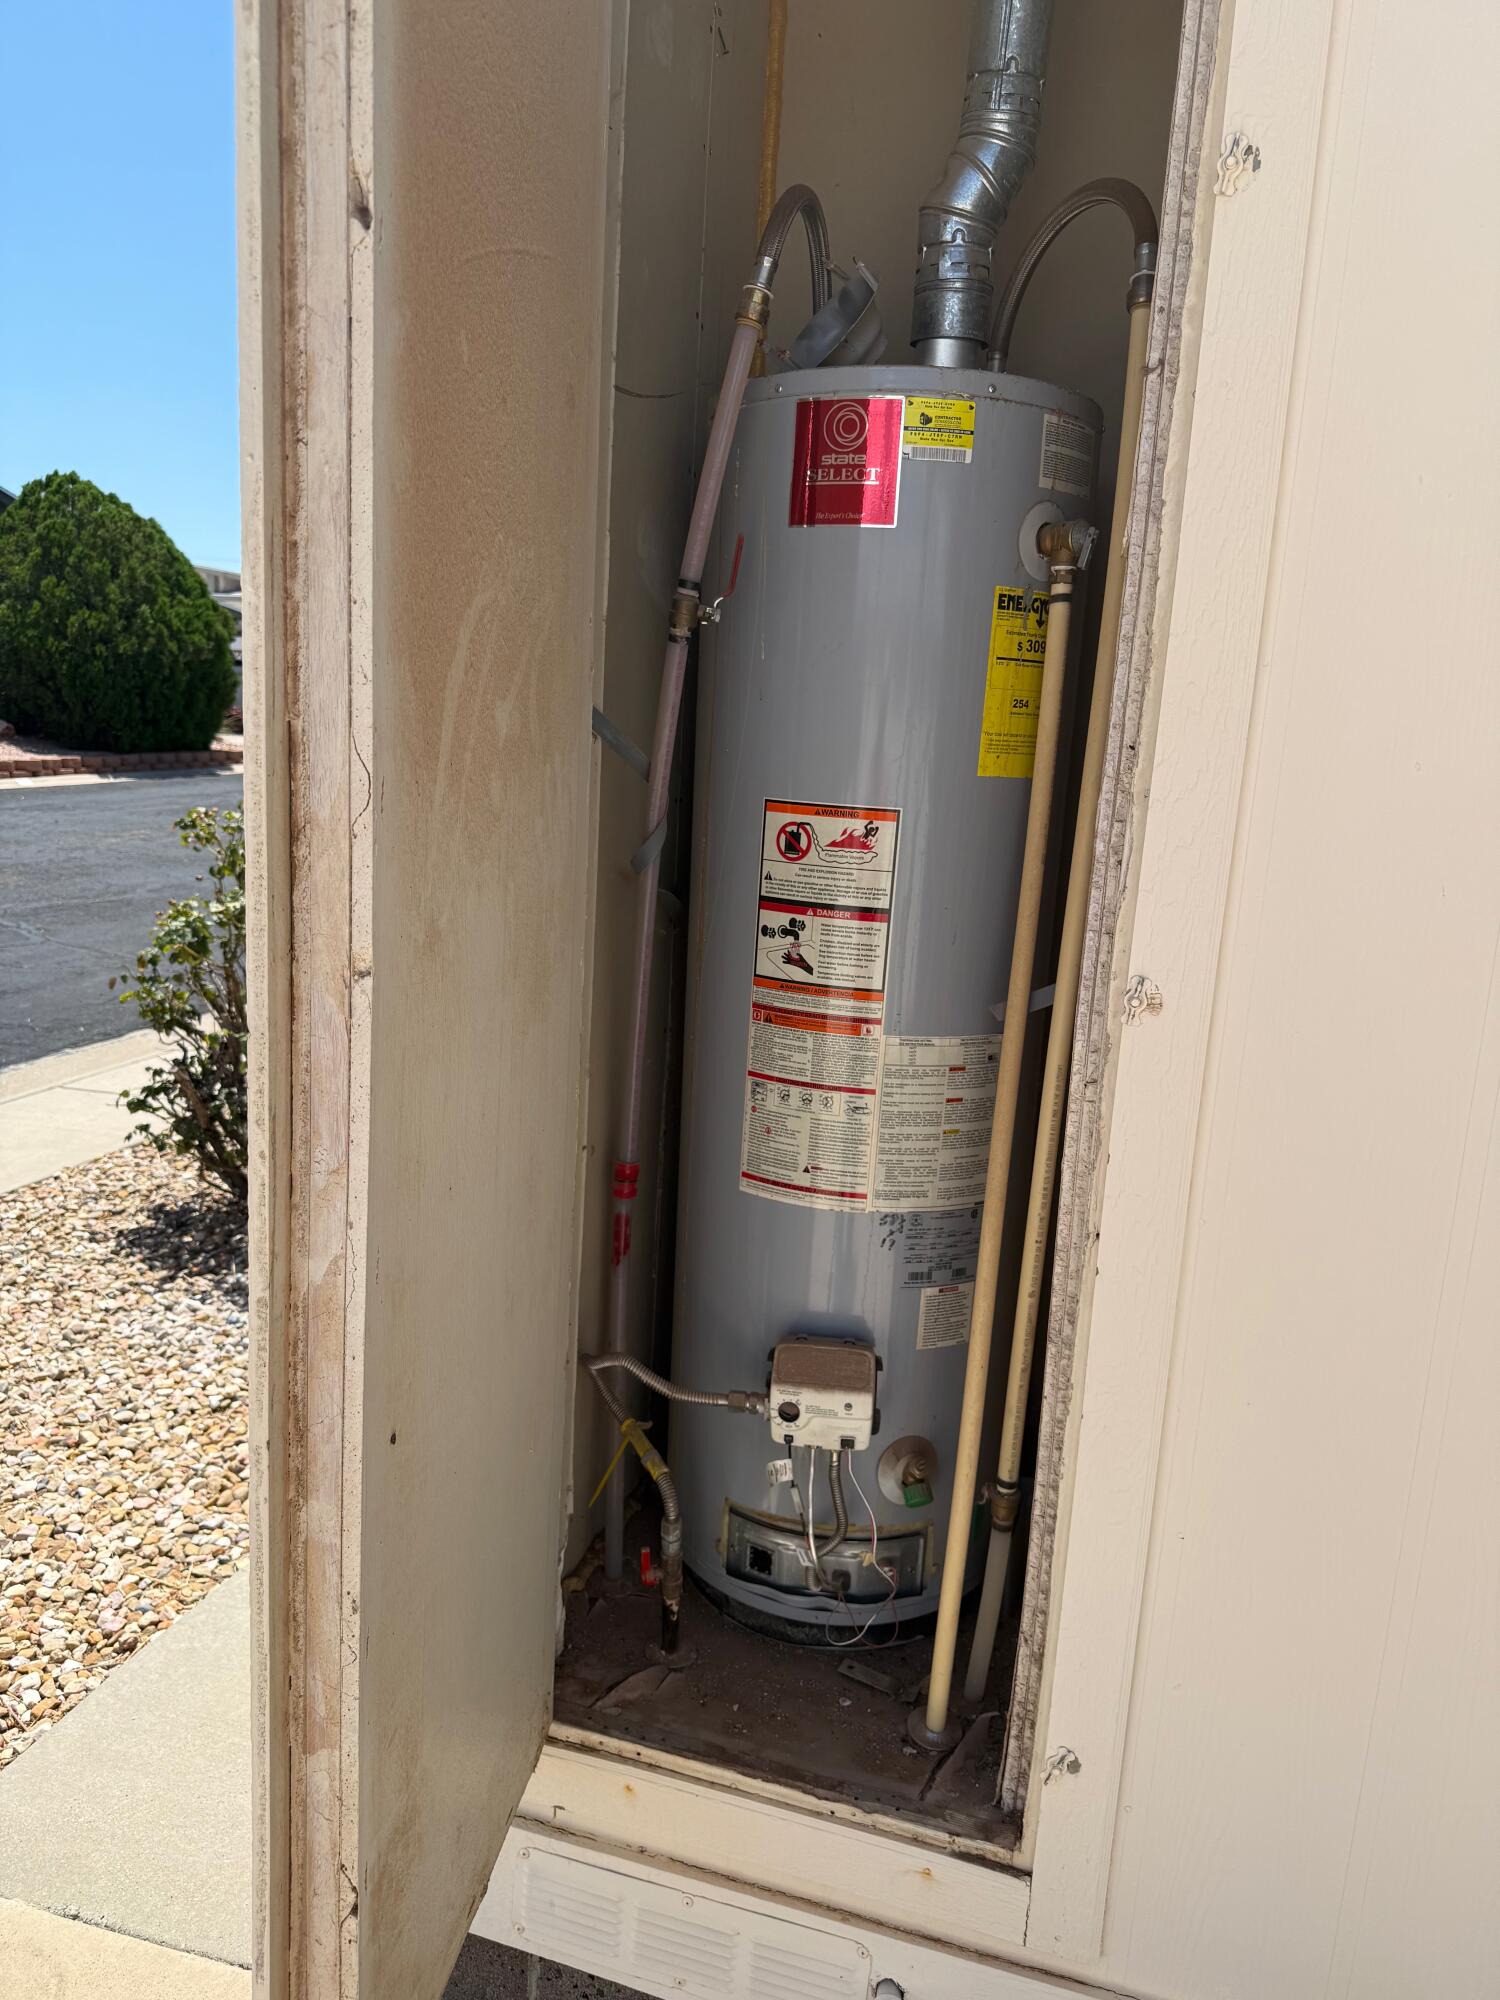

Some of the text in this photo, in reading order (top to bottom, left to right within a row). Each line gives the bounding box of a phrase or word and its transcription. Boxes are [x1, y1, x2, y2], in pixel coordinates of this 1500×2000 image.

[822, 453, 866, 465] state
[808, 467, 880, 481] SELECT
[1026, 640, 1046, 654] 309
[1012, 699, 1029, 709] 254
[820, 808, 860, 818] WARNING
[816, 908, 850, 919] DANGER
[784, 984, 809, 992] WARNING
[813, 987, 853, 997] ADVERTENCIA
